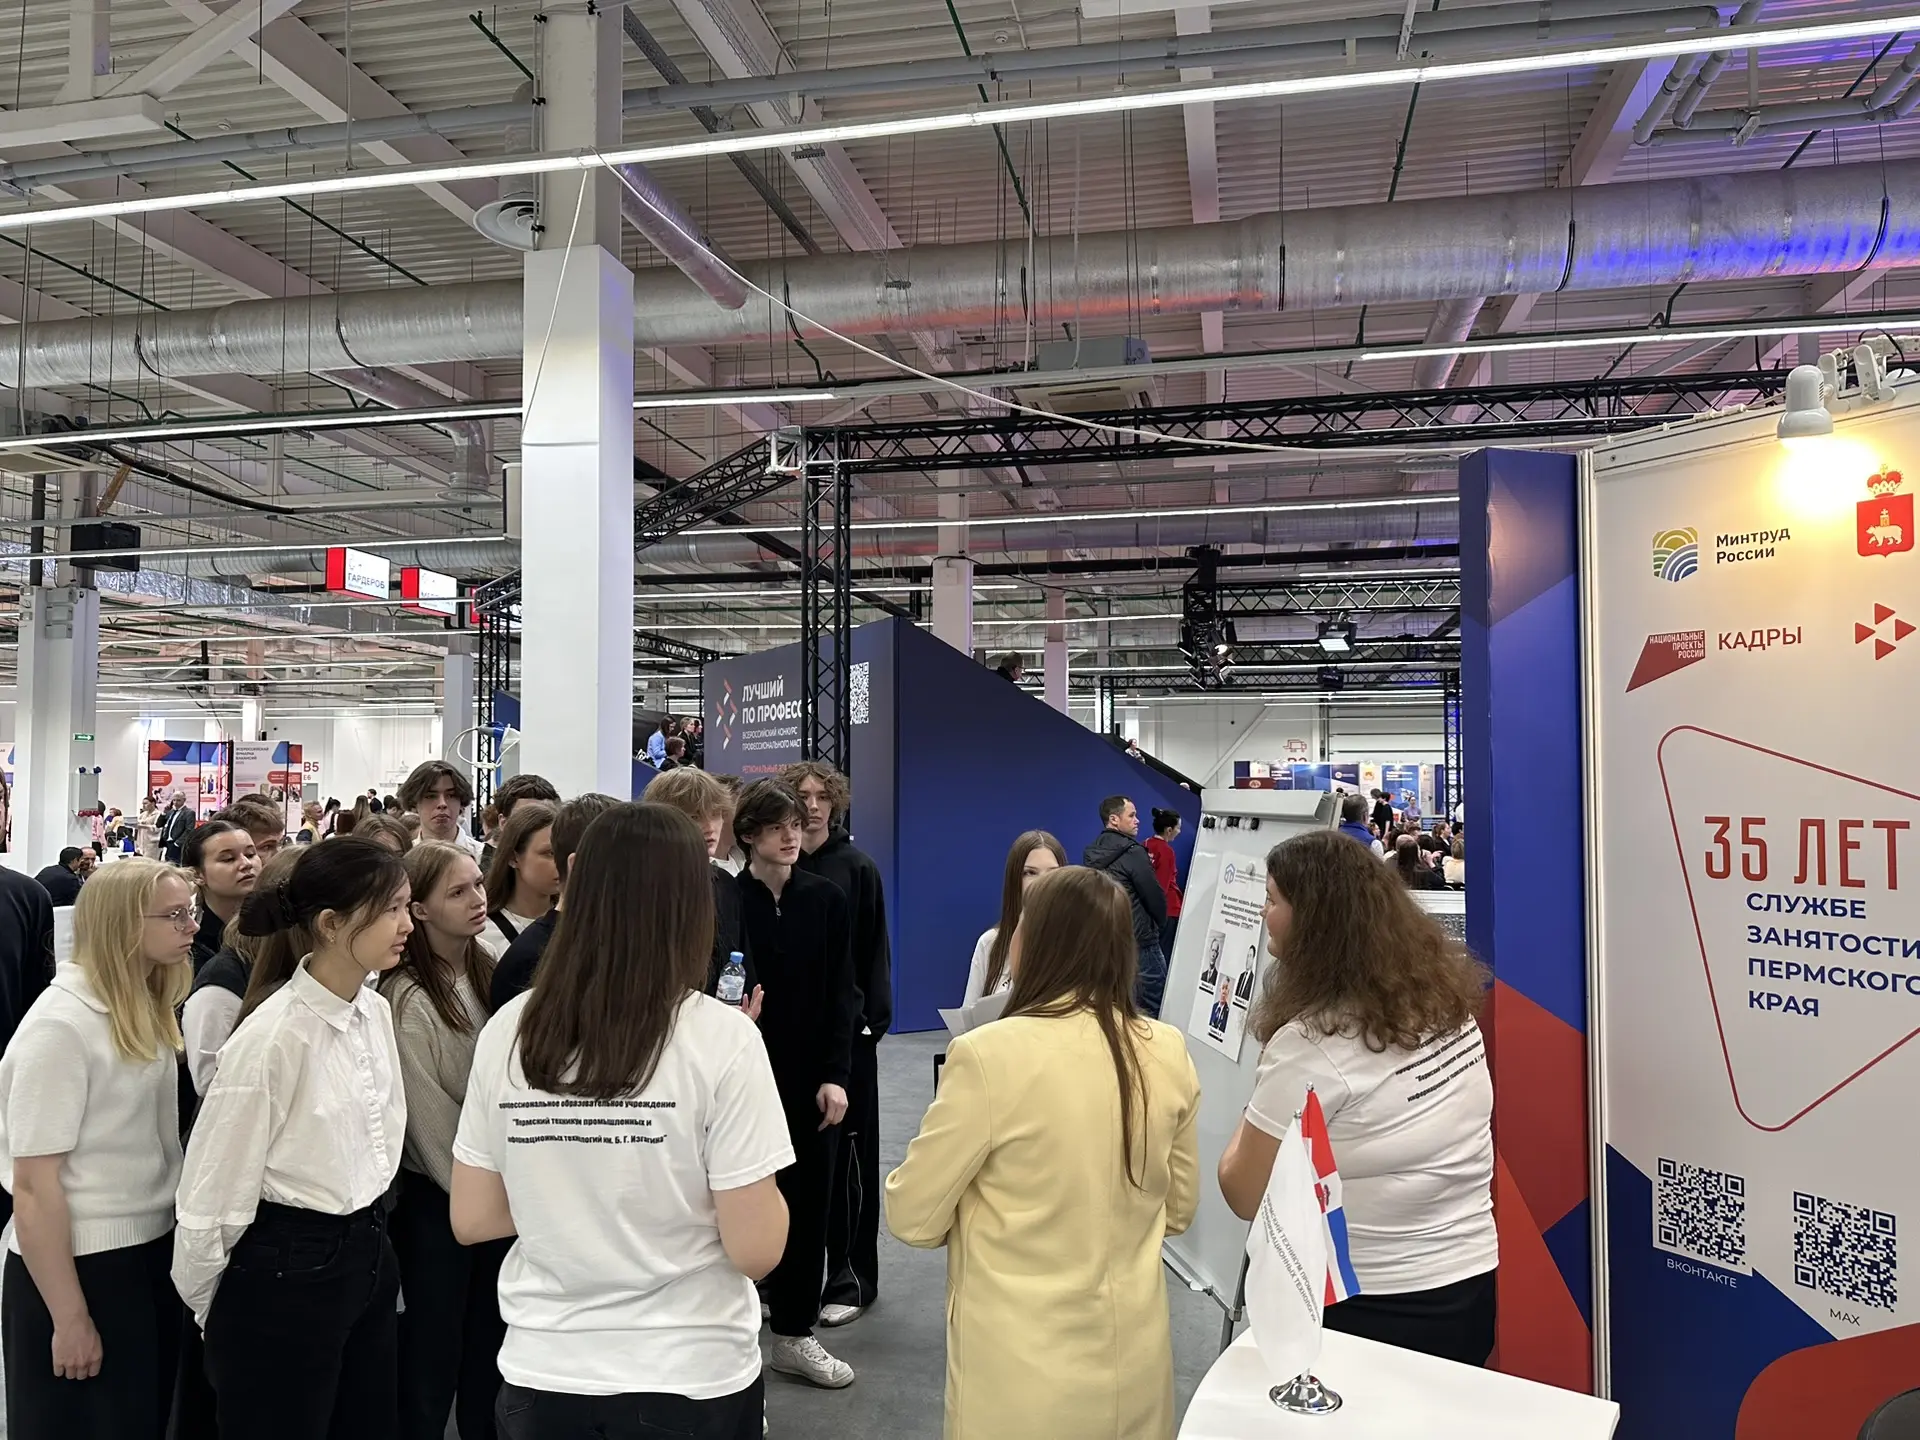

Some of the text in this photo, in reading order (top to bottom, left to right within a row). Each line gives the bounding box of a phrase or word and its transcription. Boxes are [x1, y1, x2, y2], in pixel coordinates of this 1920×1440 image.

[1716, 528, 1791, 548] Минтруд
[1716, 547, 1775, 564] России
[348, 573, 385, 589] ГАРДЕРОБ
[1649, 631, 1705, 645] НАЦИОНАЛЬНЫЕ
[1672, 641, 1705, 651] ПРОЕКТЫ
[1718, 626, 1802, 651] КАДРЫ
[1678, 649, 1705, 659] РОССИИ
[742, 675, 784, 703] ЛУЧШИЙ
[742, 707, 755, 724] ПО
[778, 726, 798, 736] КОНКУРС
[1704, 816, 1910, 890] 35 ЛЕТ
[1746, 892, 1867, 919] СЛУЖБЕ
[1747, 925, 1920, 959] ЗАНЯТОСТИ
[1749, 991, 1819, 1017] КРАЯ
[625, 1101, 676, 1109] учреждение
[1279, 1232, 1303, 1273] ТЕХНИКУМ
[1666, 1258, 1737, 1288] ВКОНТАКТЕ
